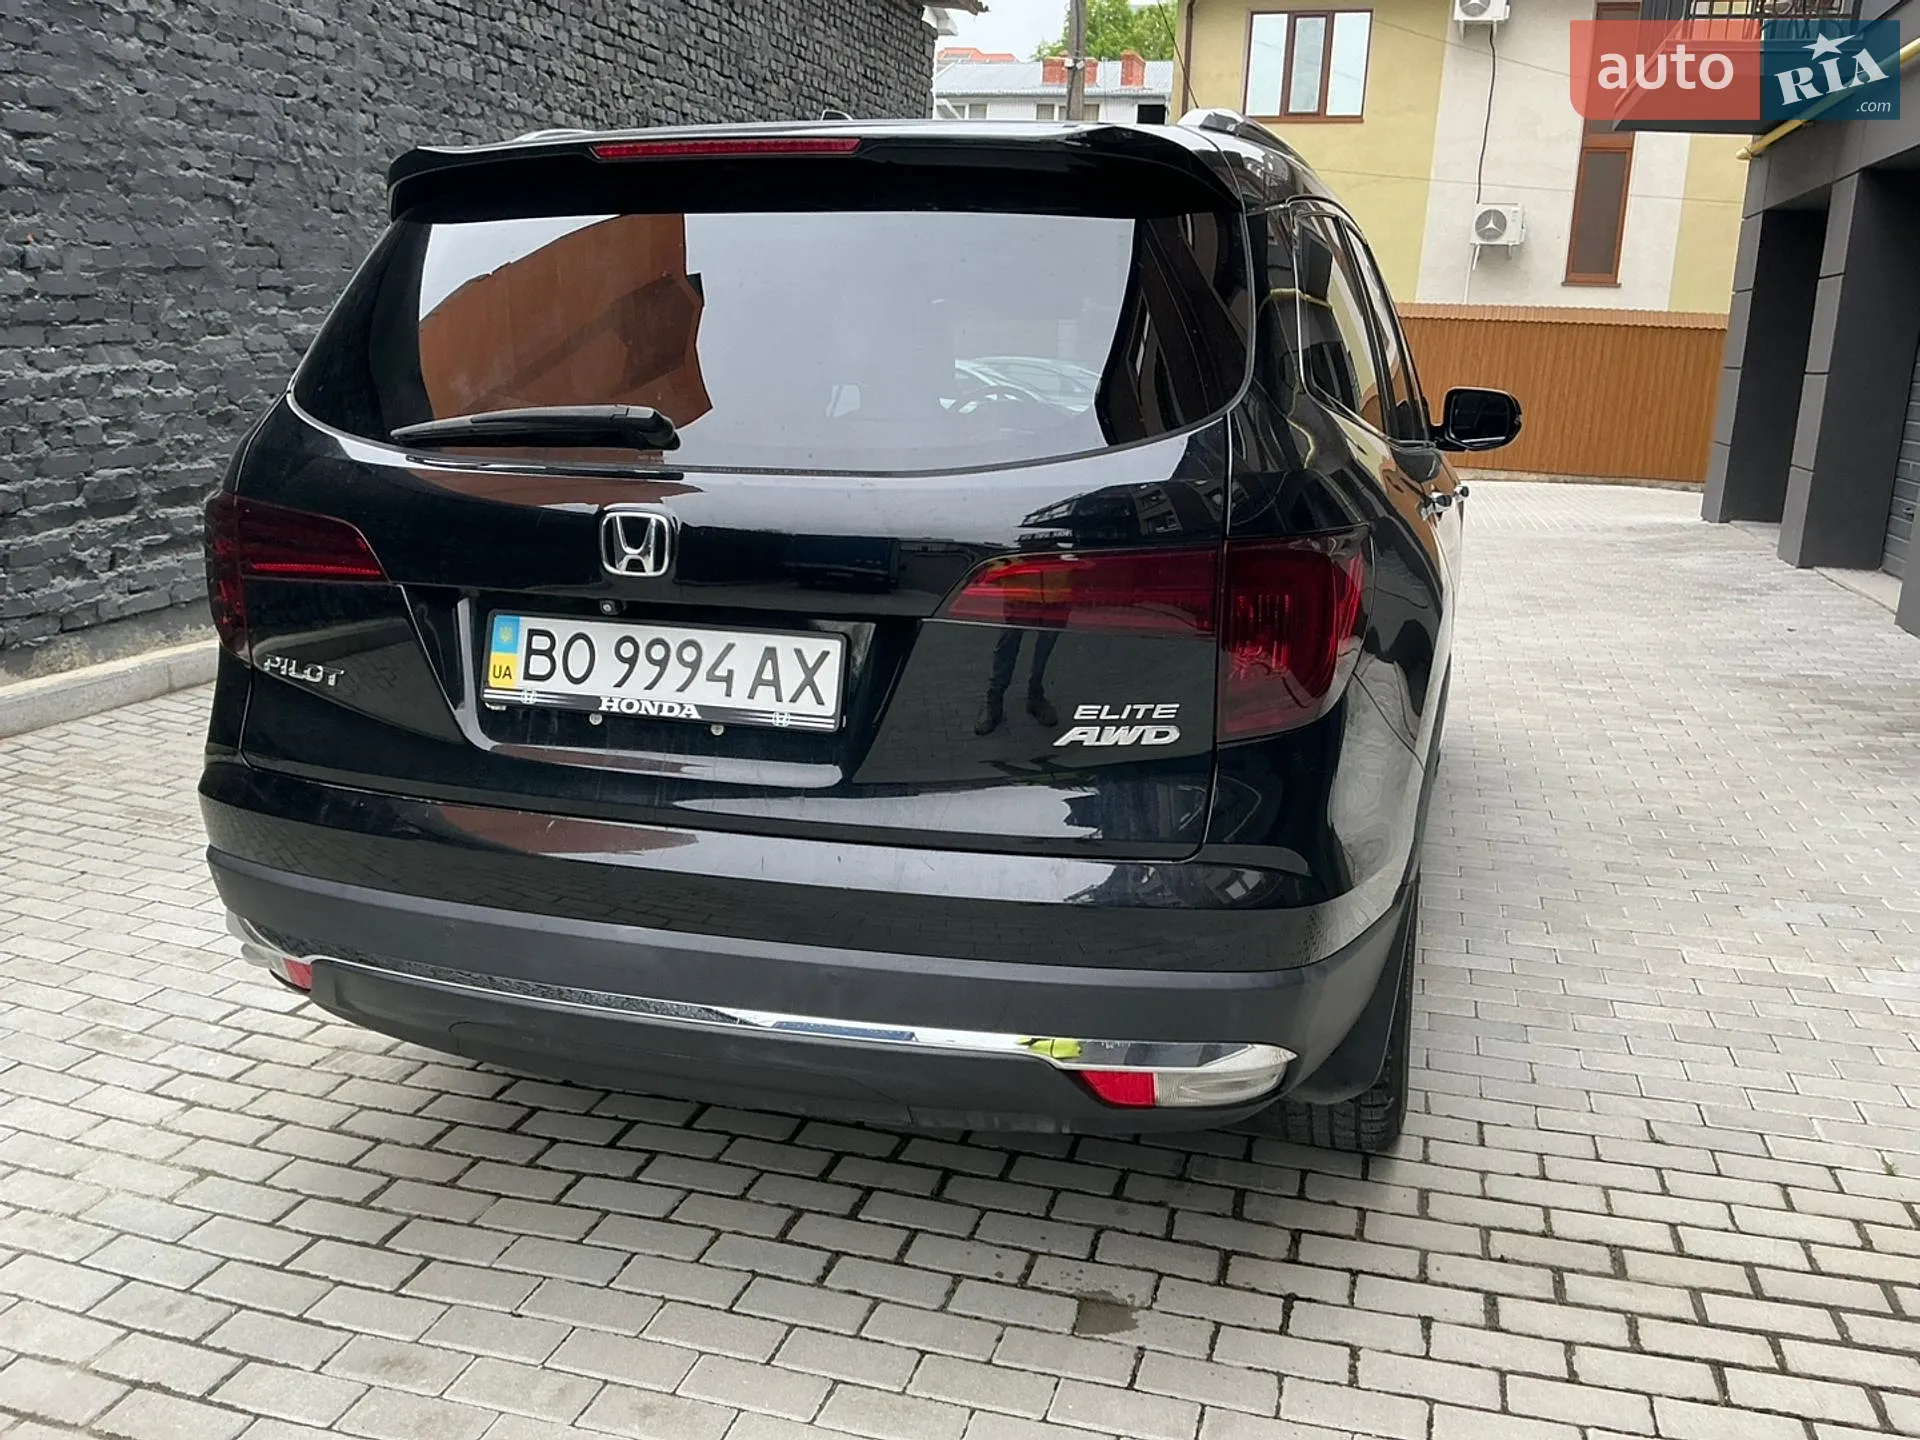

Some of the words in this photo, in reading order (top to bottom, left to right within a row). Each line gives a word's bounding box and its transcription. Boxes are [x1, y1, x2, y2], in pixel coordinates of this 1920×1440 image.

[263, 654, 345, 686] PILOT
[493, 664, 513, 681] UA
[523, 628, 596, 685] BO
[613, 636, 736, 697] 9994
[747, 646, 831, 706] AX
[599, 697, 701, 719] HONDA
[1073, 703, 1180, 720] ELITE
[1052, 725, 1181, 747] AWD
